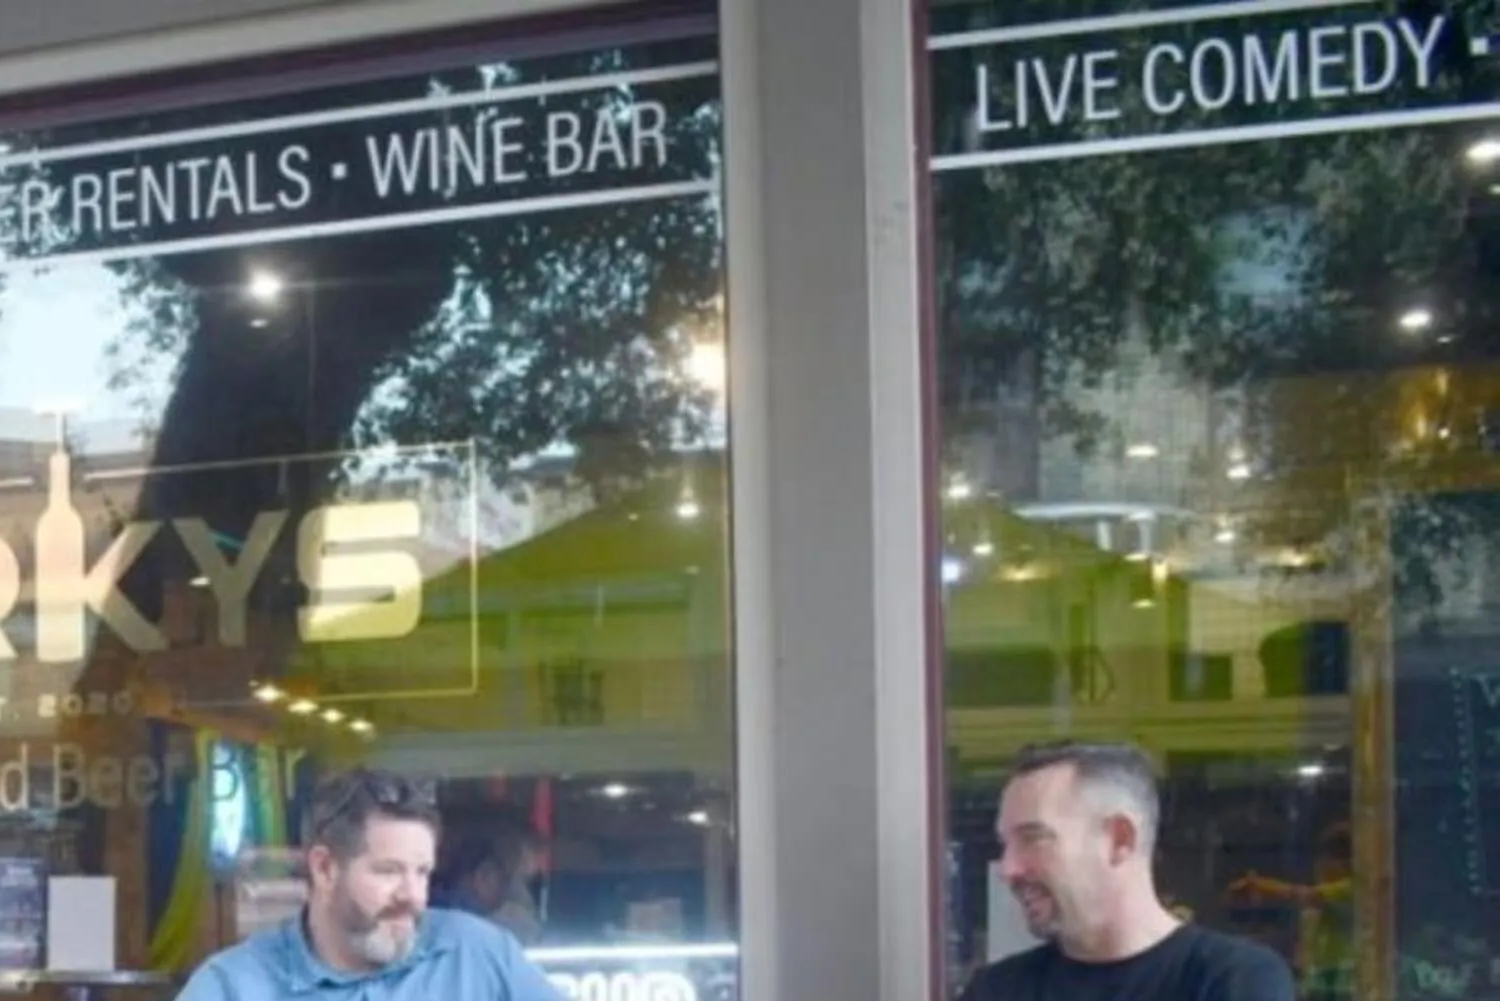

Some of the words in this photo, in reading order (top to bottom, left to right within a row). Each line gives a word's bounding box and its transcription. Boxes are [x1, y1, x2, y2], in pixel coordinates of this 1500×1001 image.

[976, 50, 1121, 132] LIVE
[1142, 16, 1445, 115] COMEDY
[72, 145, 312, 232] RENTALS
[365, 116, 527, 198] WINE
[547, 101, 667, 177] BAR
[52, 739, 186, 811] Beer
[205, 738, 310, 802] Br
